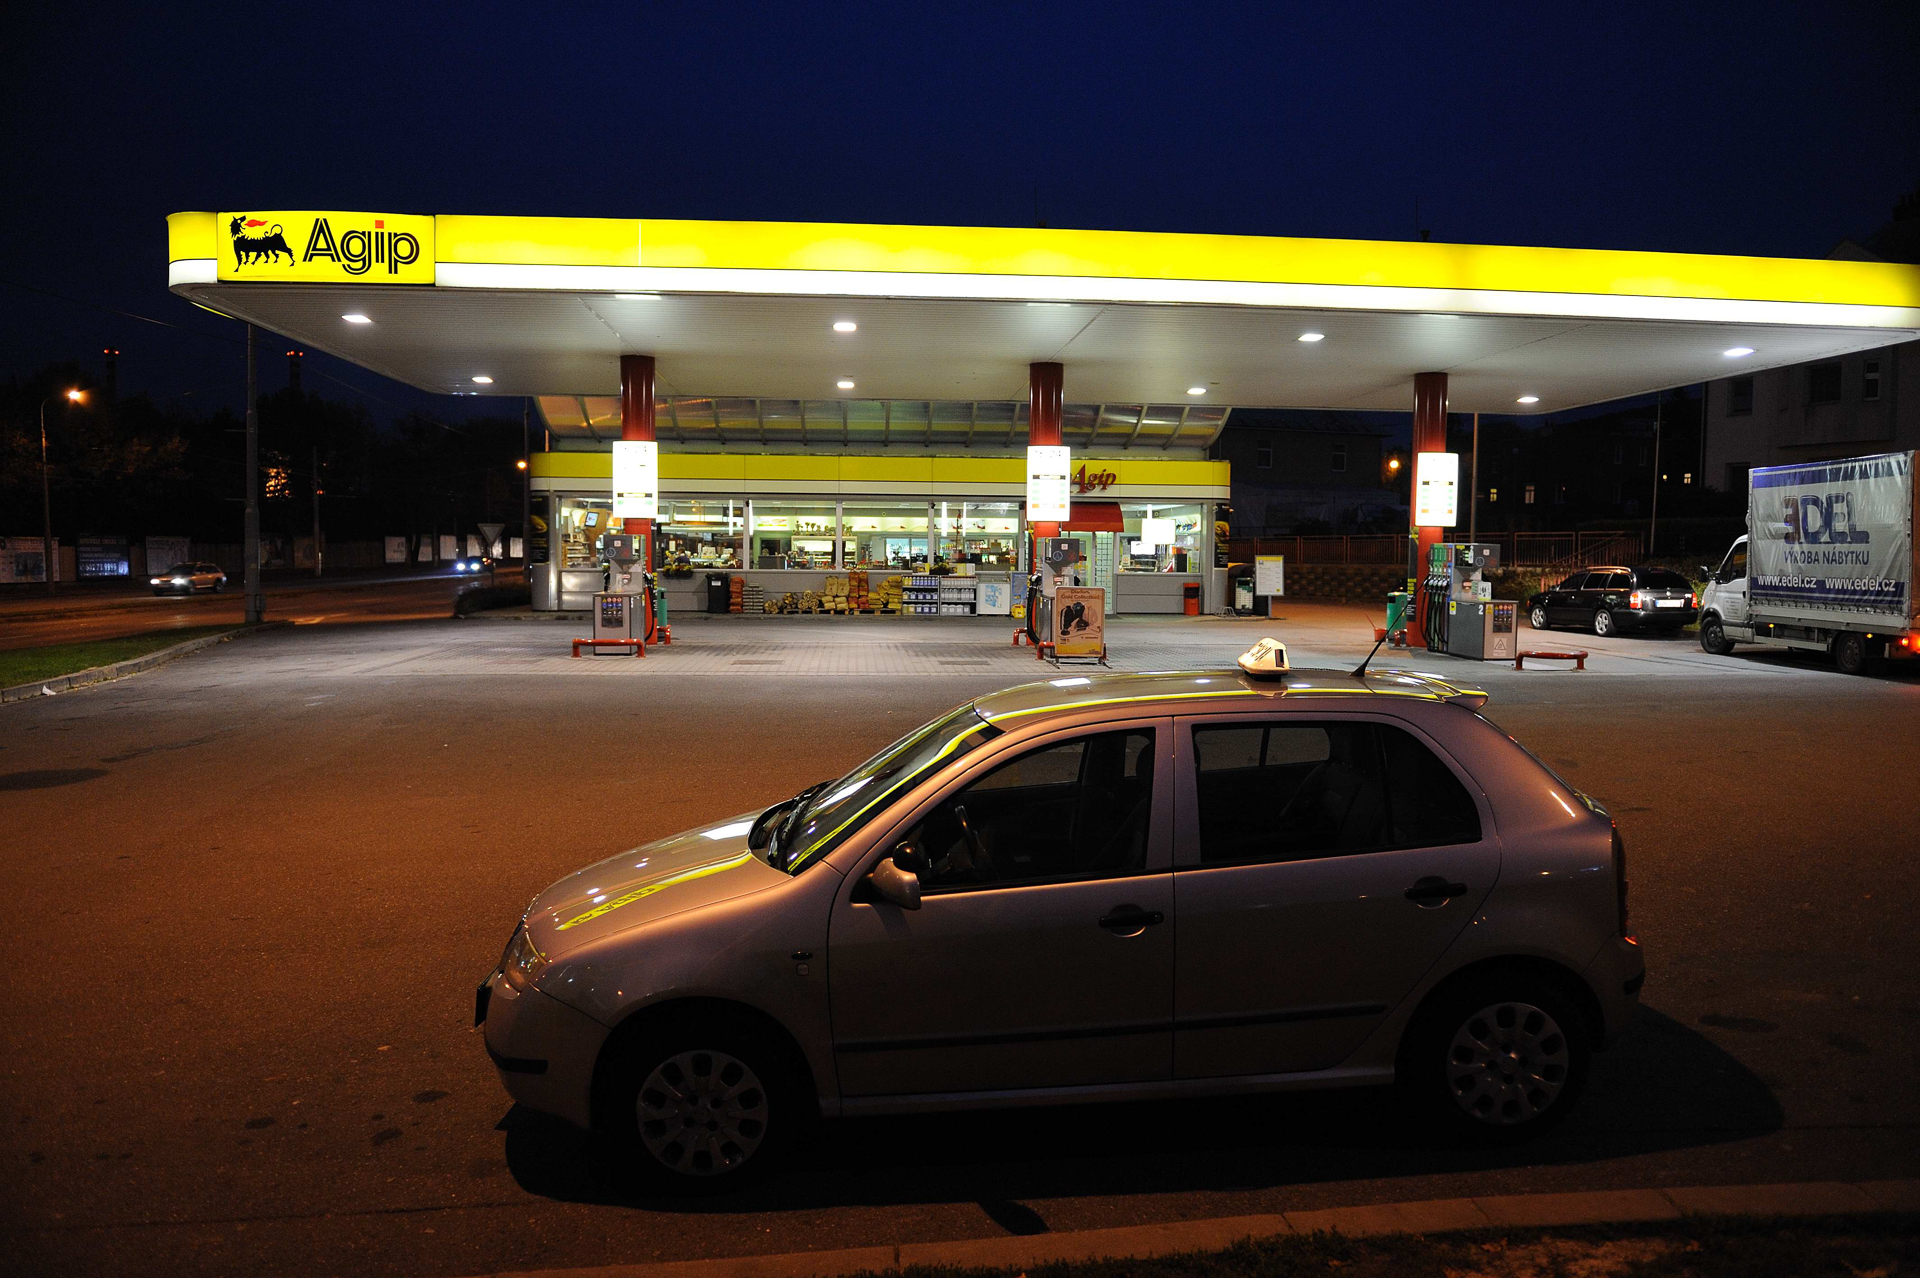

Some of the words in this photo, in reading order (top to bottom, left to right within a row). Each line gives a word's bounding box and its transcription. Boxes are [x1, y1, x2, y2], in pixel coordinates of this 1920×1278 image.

[302, 217, 420, 275] Agip
[1072, 463, 1117, 494] Agip
[1784, 546, 1820, 565] VÝROBA
[1823, 546, 1870, 566] NÁBYTKU
[1757, 573, 1817, 589] www.edel.cz
[1825, 576, 1896, 592] www.edel.cz
[1478, 604, 1484, 615] 2
